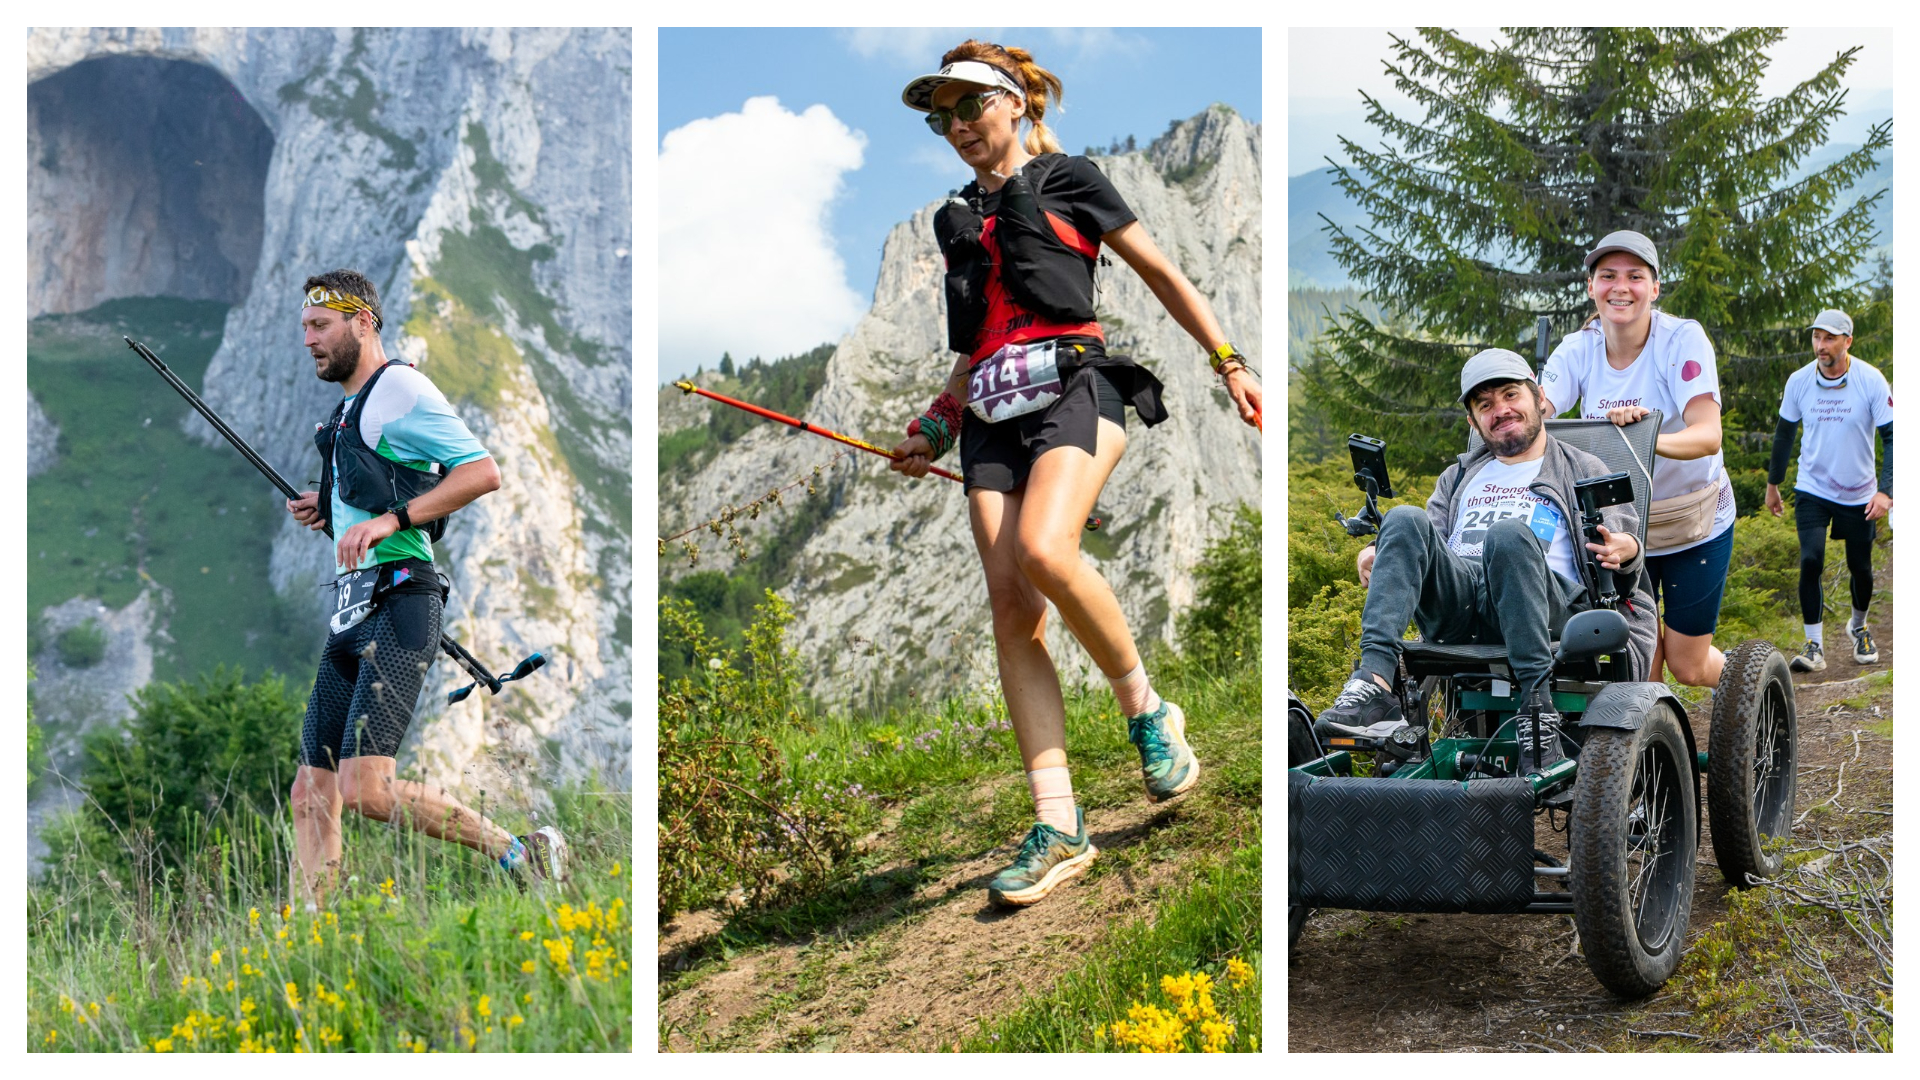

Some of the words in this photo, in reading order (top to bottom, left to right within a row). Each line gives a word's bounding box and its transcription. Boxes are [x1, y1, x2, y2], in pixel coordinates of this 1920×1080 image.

[972, 358, 1020, 400] 514
[1597, 397, 1642, 410] Stronger
[1816, 398, 1844, 406] Stronger
[1810, 407, 1835, 415] through
[1482, 483, 1531, 495] Stronge
[337, 583, 351, 610] 69
